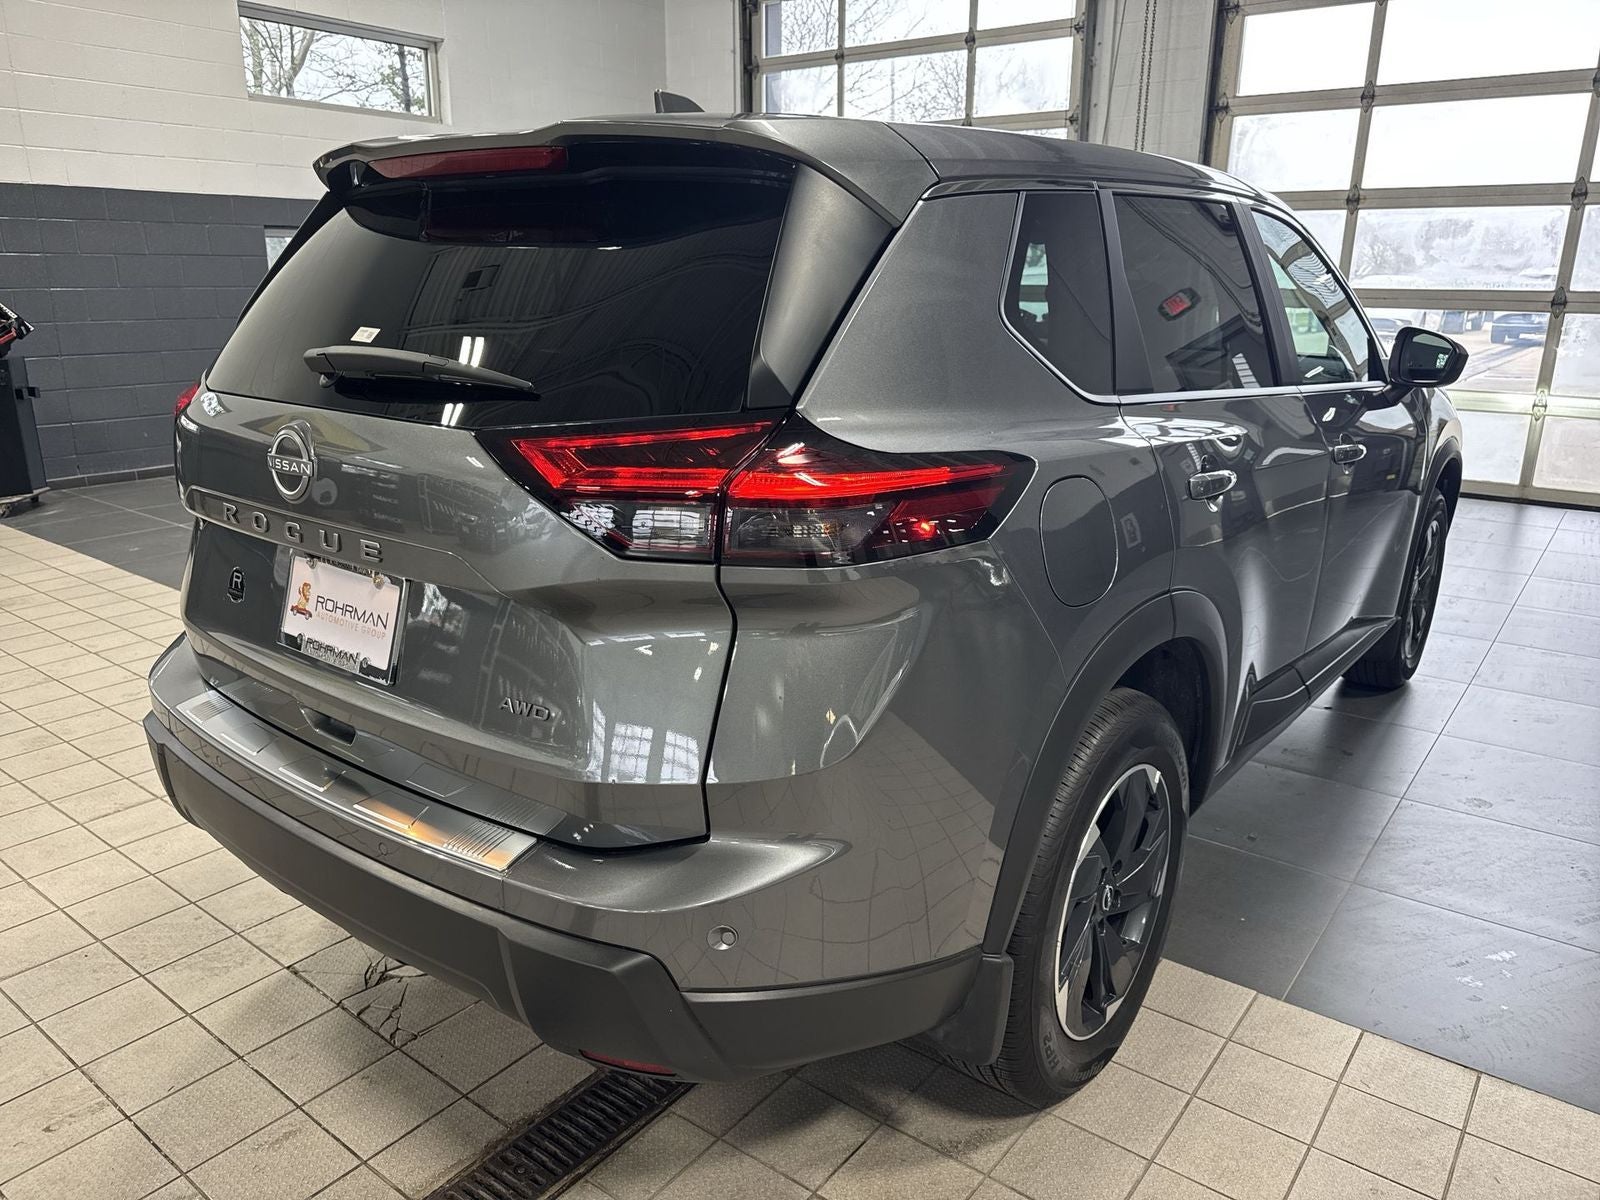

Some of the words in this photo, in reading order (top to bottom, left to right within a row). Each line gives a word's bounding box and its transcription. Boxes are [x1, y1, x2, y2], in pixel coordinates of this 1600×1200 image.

[267, 455, 311, 475] NISSAN
[222, 502, 383, 563] ROGUE
[231, 571, 242, 589] R
[315, 595, 389, 630] ROHRMAN
[316, 611, 360, 632] AUTOMOTIVE
[360, 625, 386, 640] GROUP
[305, 637, 359, 665] ROHRMAN
[499, 696, 551, 721] AWD
